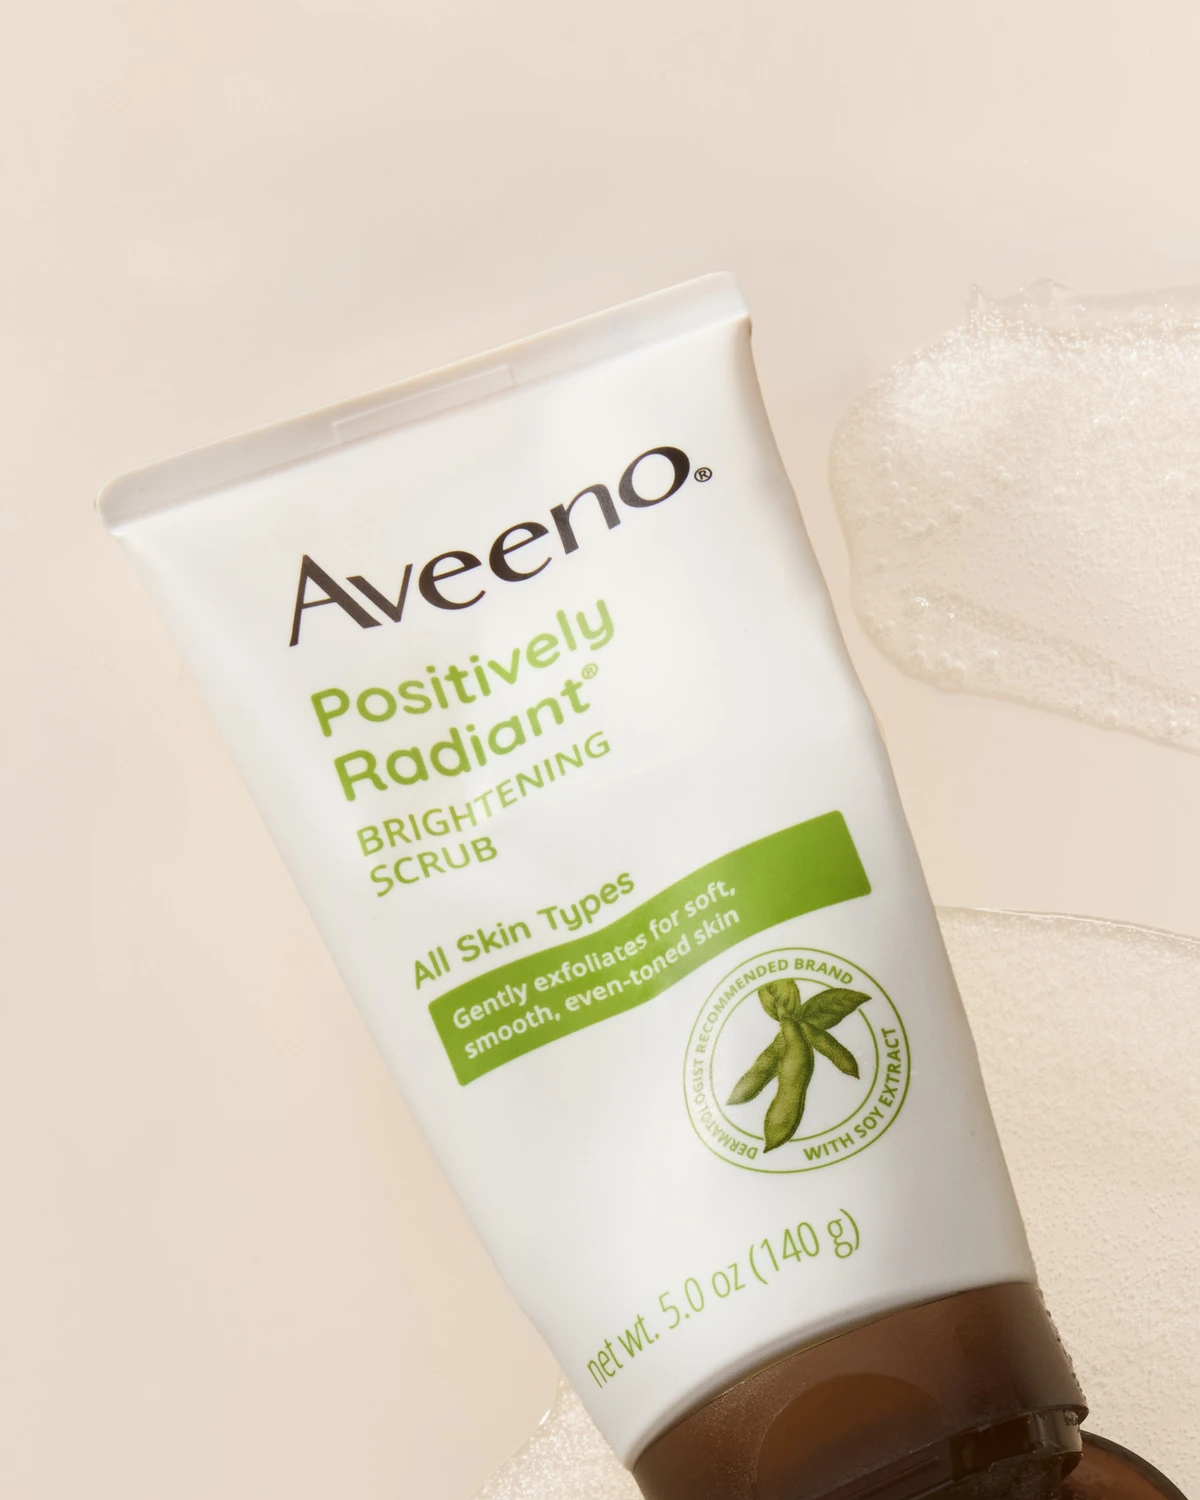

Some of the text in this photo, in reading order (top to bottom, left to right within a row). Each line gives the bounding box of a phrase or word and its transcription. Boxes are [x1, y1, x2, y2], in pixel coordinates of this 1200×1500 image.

[311, 599, 615, 737] Positively
[356, 731, 611, 856] BRIGHTENING
[369, 835, 498, 897] SCRUB
[413, 871, 635, 990] All Skin Types
[453, 880, 736, 1030] Gently exfoliates for soft,
[464, 908, 740, 1059] smooth, even-toned skin
[692, 958, 853, 1160] DERMATOLOGIST RECOMMENDED BRAND
[803, 1027, 901, 1161] WITH SOY EXTRACT
[587, 1209, 860, 1388] net wt. 5.0 oz (140 g)
